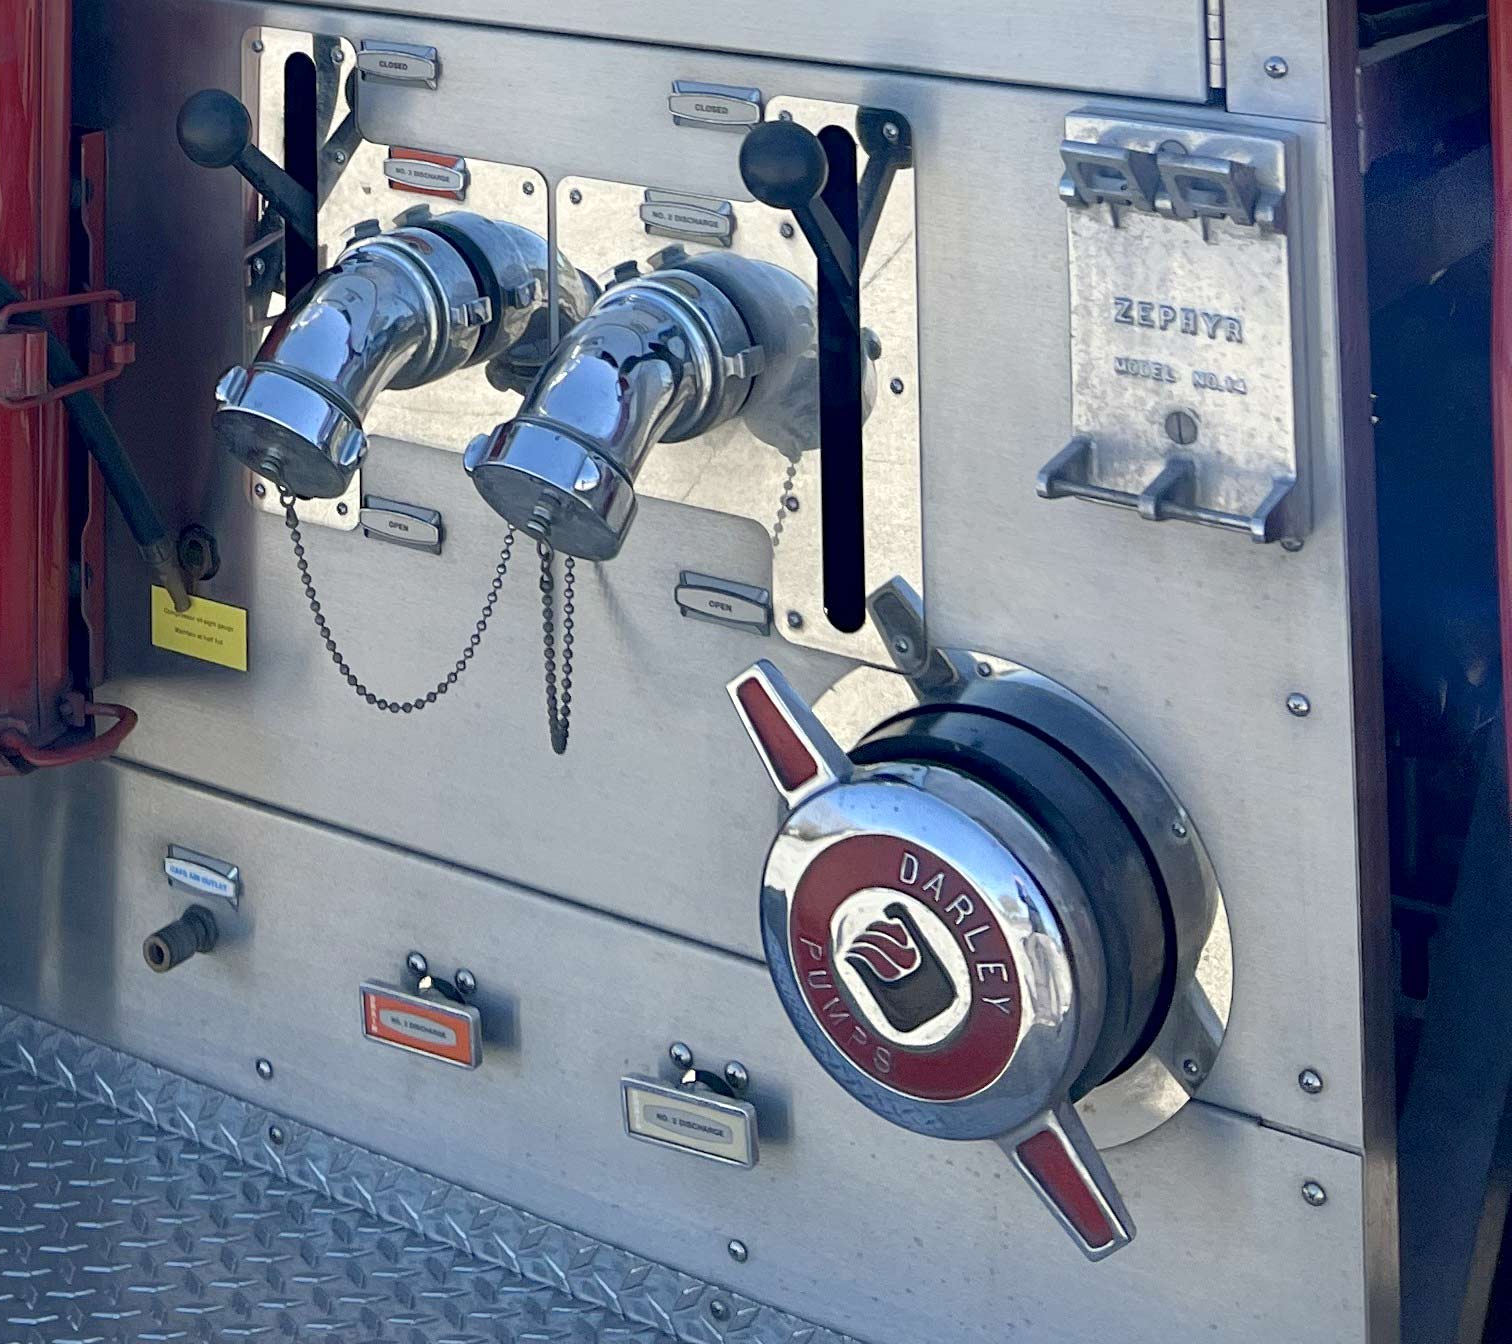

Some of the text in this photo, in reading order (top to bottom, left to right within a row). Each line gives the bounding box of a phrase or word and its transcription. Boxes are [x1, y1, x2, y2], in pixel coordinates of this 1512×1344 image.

[379, 60, 408, 71] CLOSED
[694, 103, 728, 114] CLOSED
[413, 170, 450, 183] DISCHARGE
[674, 214, 719, 228] DISCHARGE
[1113, 296, 1243, 344] ZEPHYR
[1114, 356, 1177, 383] MODEL
[388, 520, 408, 531] OPEN
[708, 600, 732, 612] OPEN
[898, 850, 1012, 1015] DARLEY
[799, 936, 892, 1075] PUMPS
[409, 1022, 447, 1039] DISCHARGE
[678, 1118, 725, 1138] DISCHARGE
